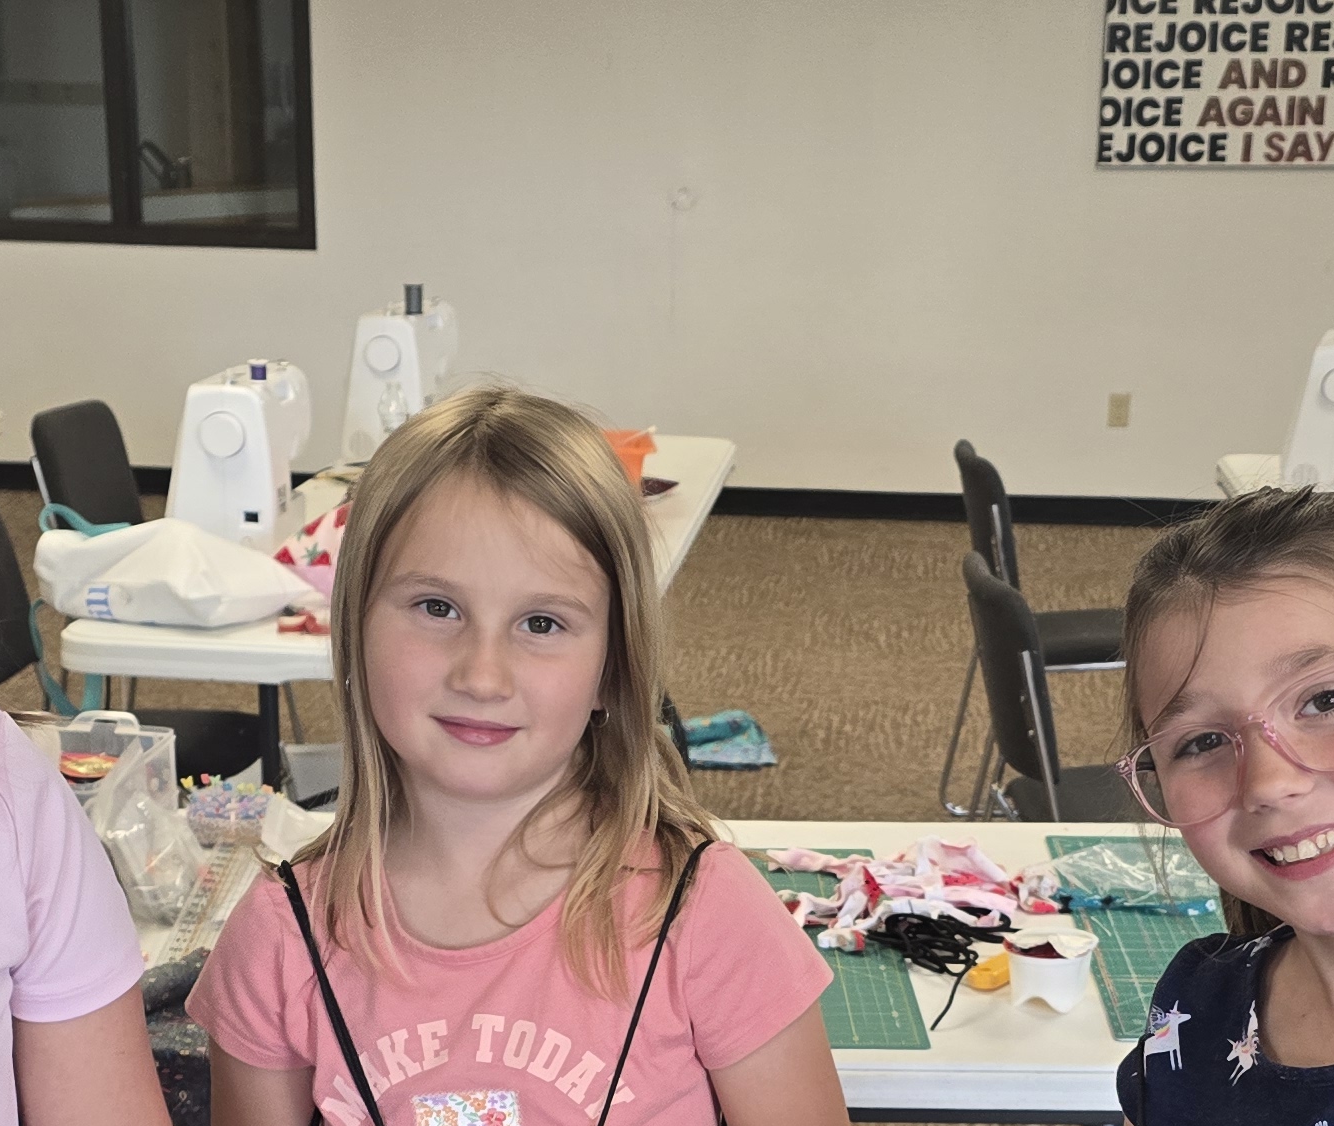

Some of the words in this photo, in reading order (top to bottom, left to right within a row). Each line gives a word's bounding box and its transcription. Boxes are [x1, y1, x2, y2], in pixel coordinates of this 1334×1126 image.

[1106, 21, 1269, 52] REJOICE
[1218, 57, 1307, 89] AND
[1197, 95, 1326, 126] AGAIN
[1097, 132, 1228, 163] EJOICE
[1240, 132, 1254, 163] I
[471, 1013, 637, 1121] TODAY
